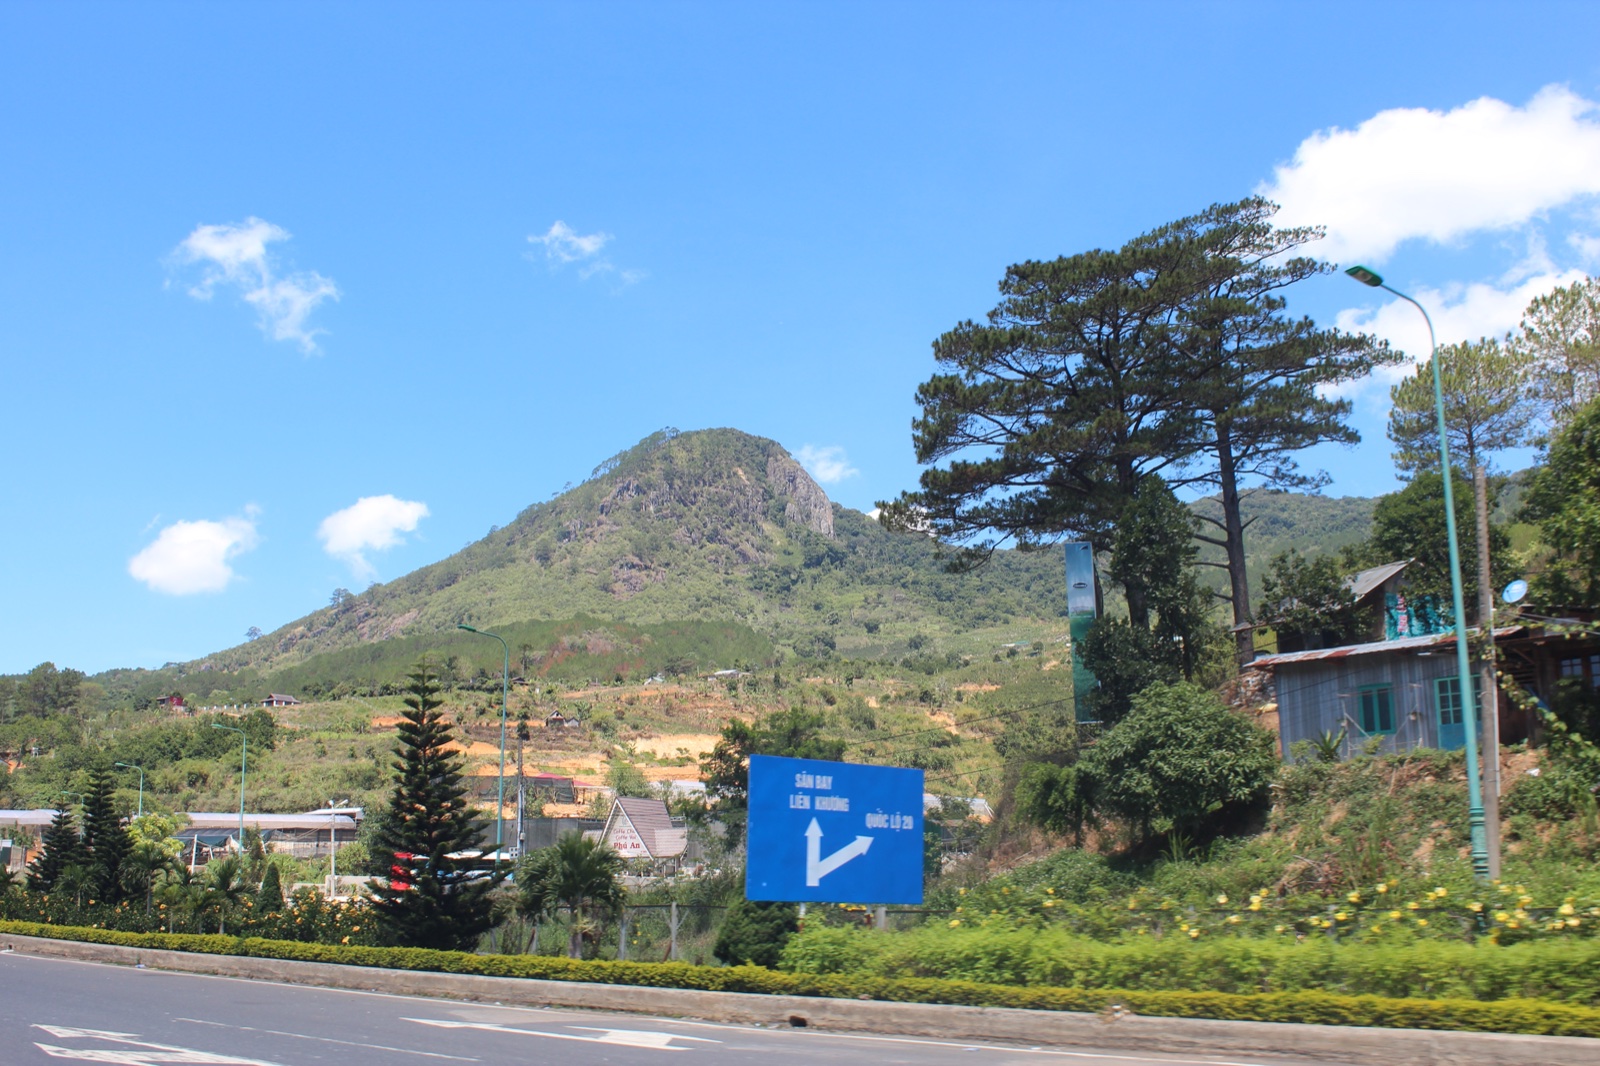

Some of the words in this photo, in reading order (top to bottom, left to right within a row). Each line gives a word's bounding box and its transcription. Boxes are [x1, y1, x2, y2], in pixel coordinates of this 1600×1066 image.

[795, 771, 814, 788] SÂN
[815, 775, 833, 789] BAY
[790, 792, 811, 809] LIÊN
[865, 808, 889, 829] QUỐC
[902, 815, 914, 829] 20
[613, 842, 628, 850] Phú
